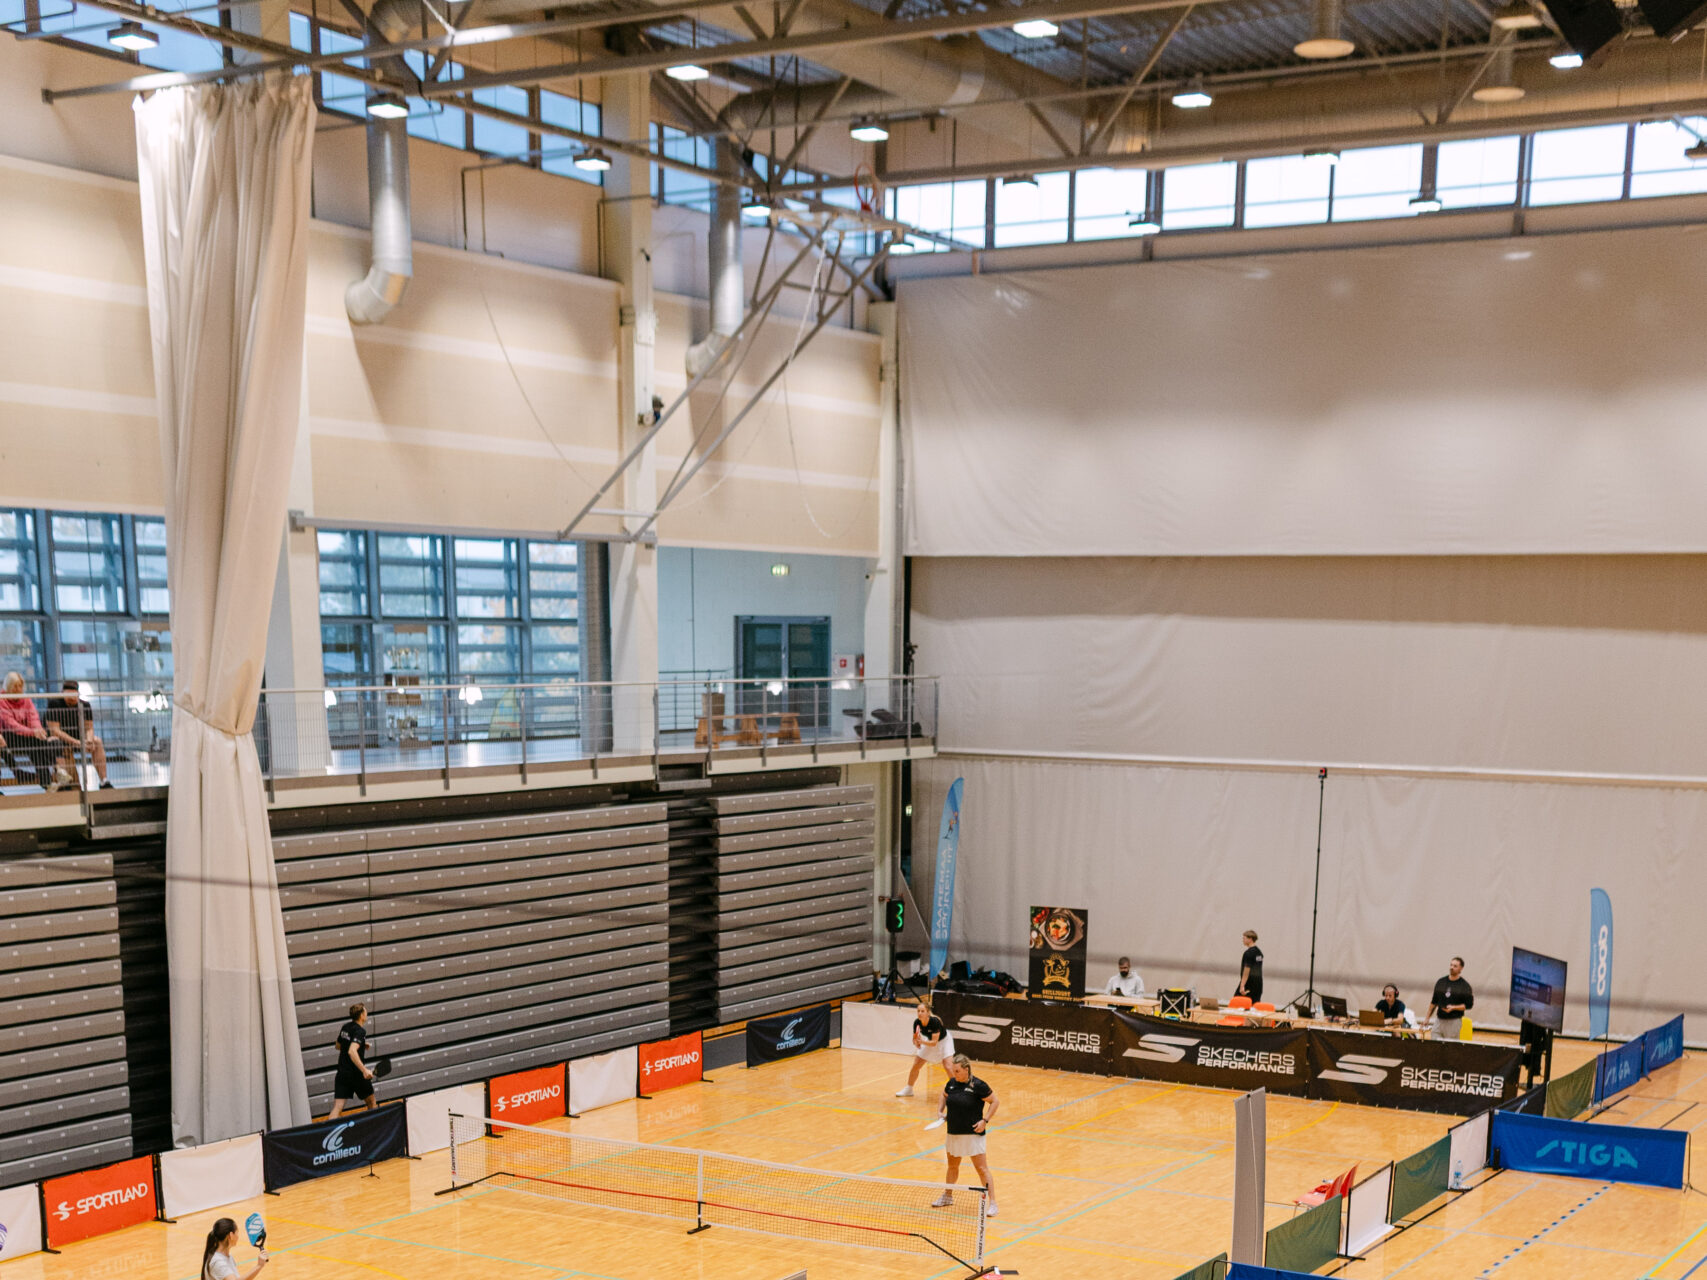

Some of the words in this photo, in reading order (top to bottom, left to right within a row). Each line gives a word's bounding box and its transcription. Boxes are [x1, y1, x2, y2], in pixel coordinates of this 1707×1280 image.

[1011, 1026, 1100, 1046] SKECHERS
[1011, 1037, 1100, 1054] PERFORMANCE
[654, 1051, 700, 1072] SPORTLAND
[1198, 1046, 1295, 1066] SKECHERS
[1197, 1058, 1295, 1075] PERFORMANCE
[1401, 1066, 1504, 1089] SKECHERS
[511, 1085, 561, 1108] SPORTLAND
[1400, 1079, 1503, 1098] PERFORMANCE
[1536, 1140, 1639, 1169] STIGA
[76, 1182, 148, 1215] SPORTLAND
